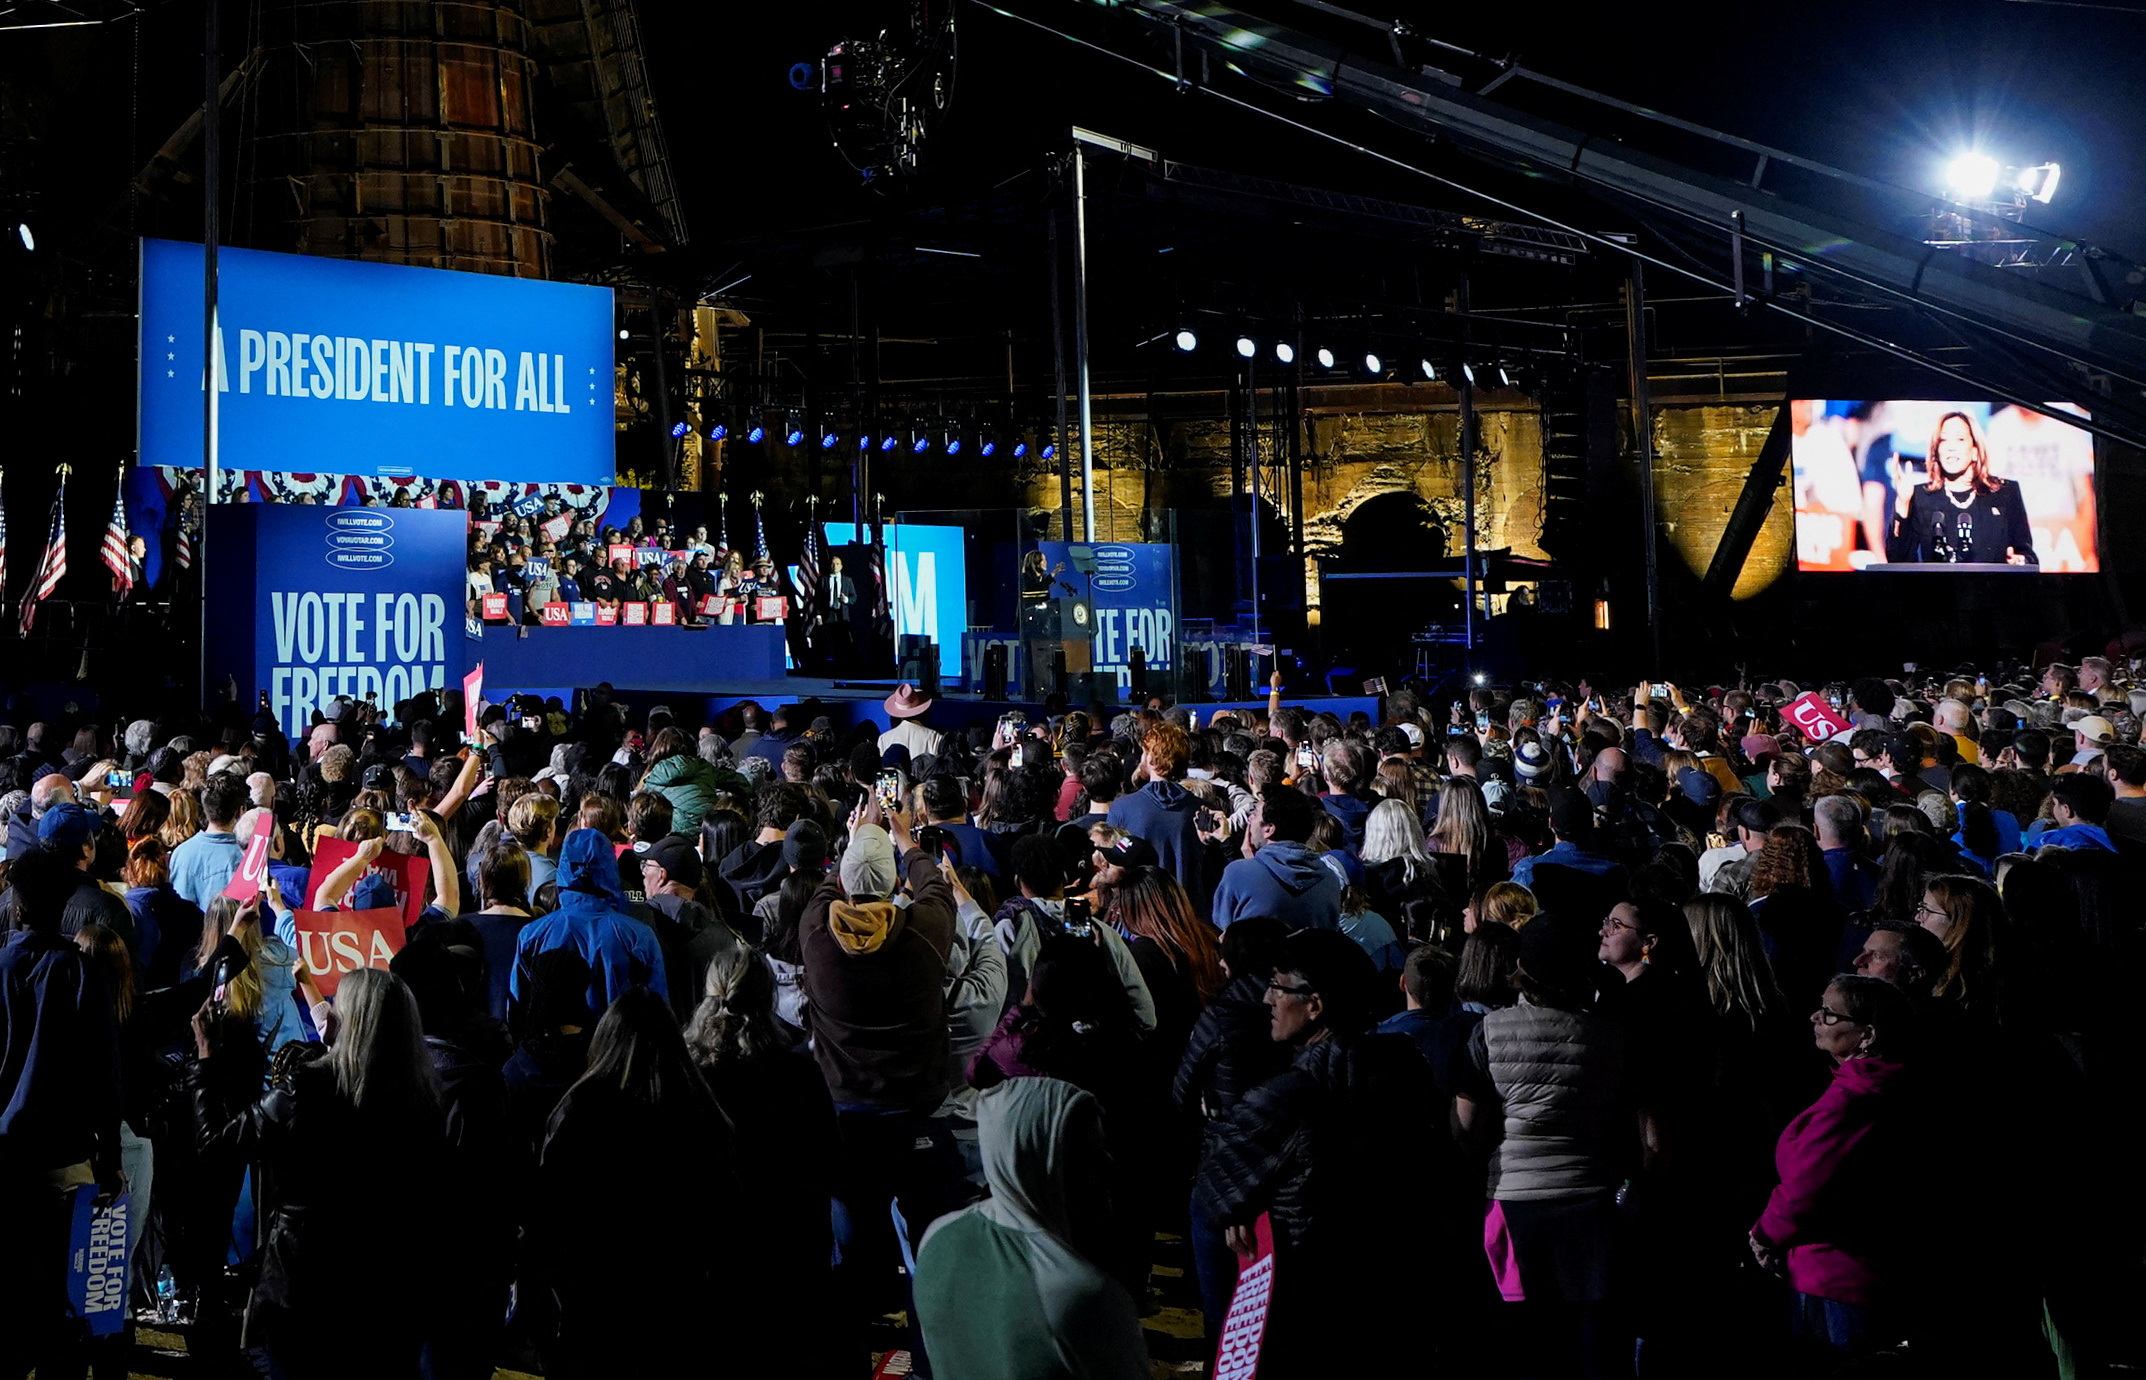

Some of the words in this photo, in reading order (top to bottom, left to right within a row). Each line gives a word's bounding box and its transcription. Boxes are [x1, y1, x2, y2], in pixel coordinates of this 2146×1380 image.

[240, 328, 435, 405] PRESIDENT
[444, 345, 507, 409] FOR
[515, 351, 570, 413] ALL
[514, 497, 545, 518] USA
[528, 561, 548, 576] USA
[638, 551, 661, 565] USA
[271, 591, 365, 664] VOTE
[375, 592, 445, 663] FOR
[545, 607, 568, 621] USA
[1125, 608, 1172, 663] FOR
[298, 930, 396, 976] USA
[108, 1203, 127, 1261] VOTE
[84, 1205, 112, 1314] FREEDOM
[104, 1265, 124, 1311] FOR
